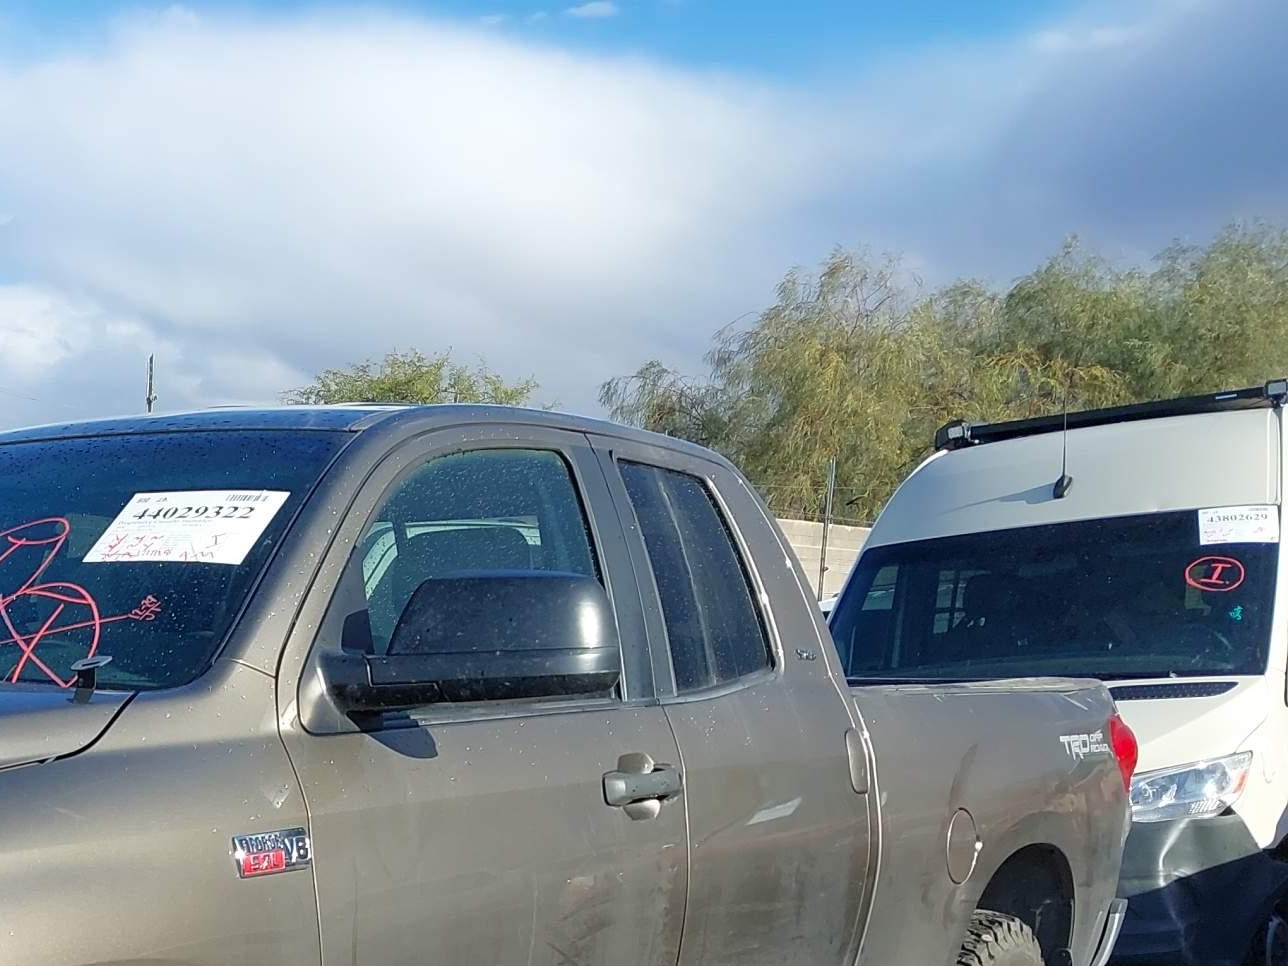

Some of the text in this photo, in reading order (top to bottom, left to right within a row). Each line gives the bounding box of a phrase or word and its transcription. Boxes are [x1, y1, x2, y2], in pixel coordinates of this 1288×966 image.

[132, 505, 256, 520] 44029322
[1059, 733, 1090, 760] TRD
[284, 836, 311, 863] V8
